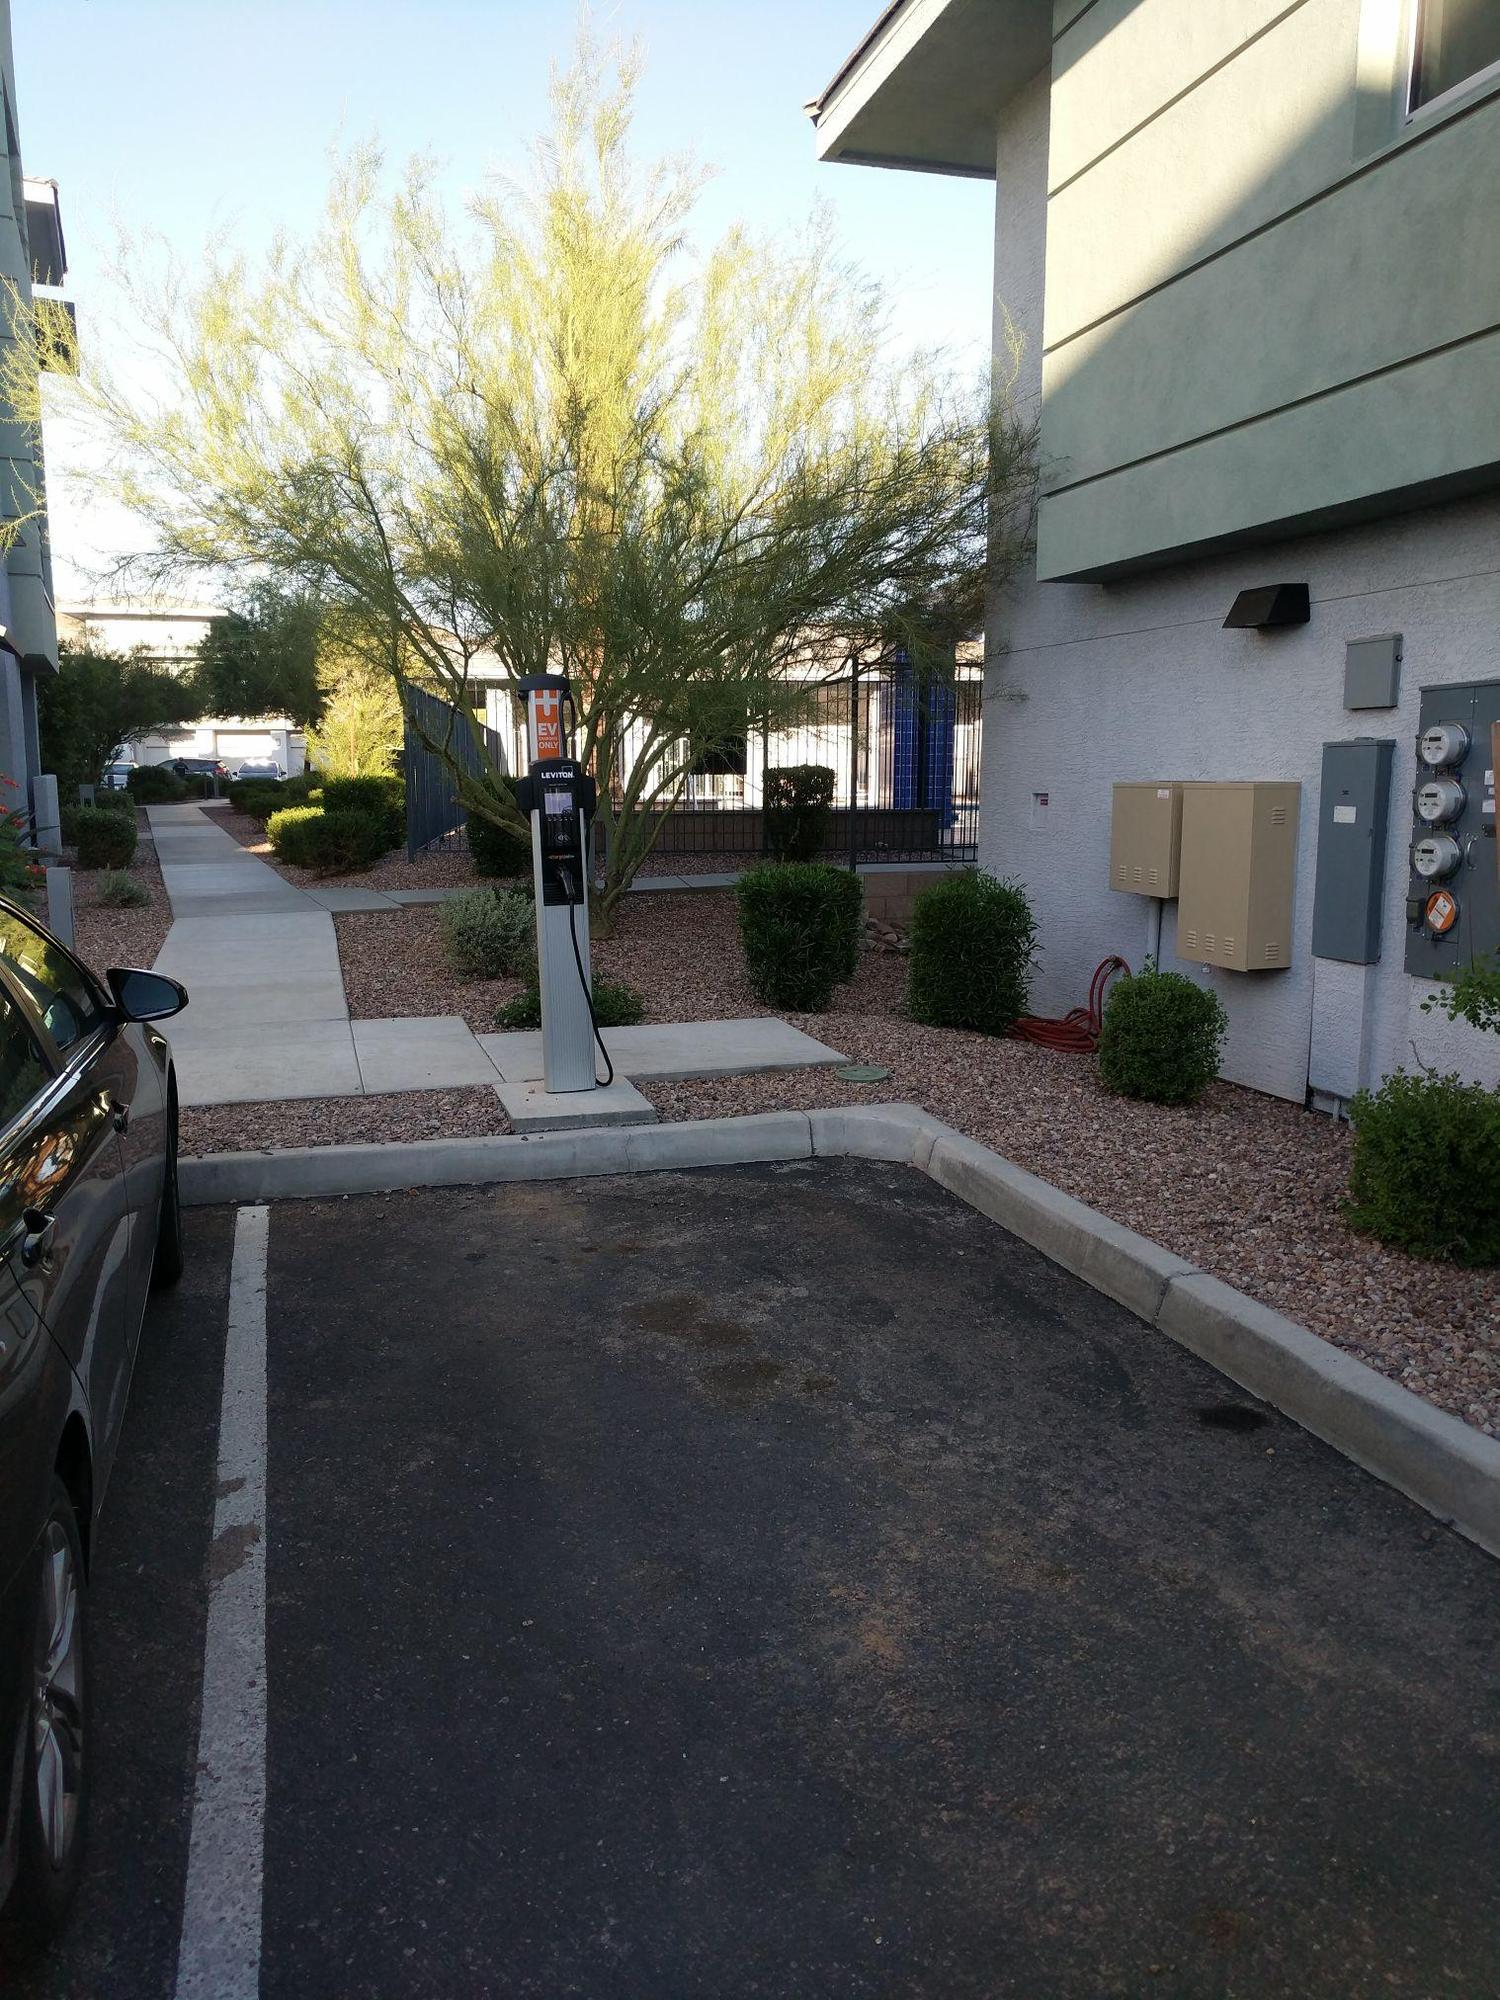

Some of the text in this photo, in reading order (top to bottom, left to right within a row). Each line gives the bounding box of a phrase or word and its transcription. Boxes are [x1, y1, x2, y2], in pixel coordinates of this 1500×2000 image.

[538, 722, 558, 735] EV
[538, 741, 559, 749] ONLY
[541, 771, 573, 779] LEVITON
